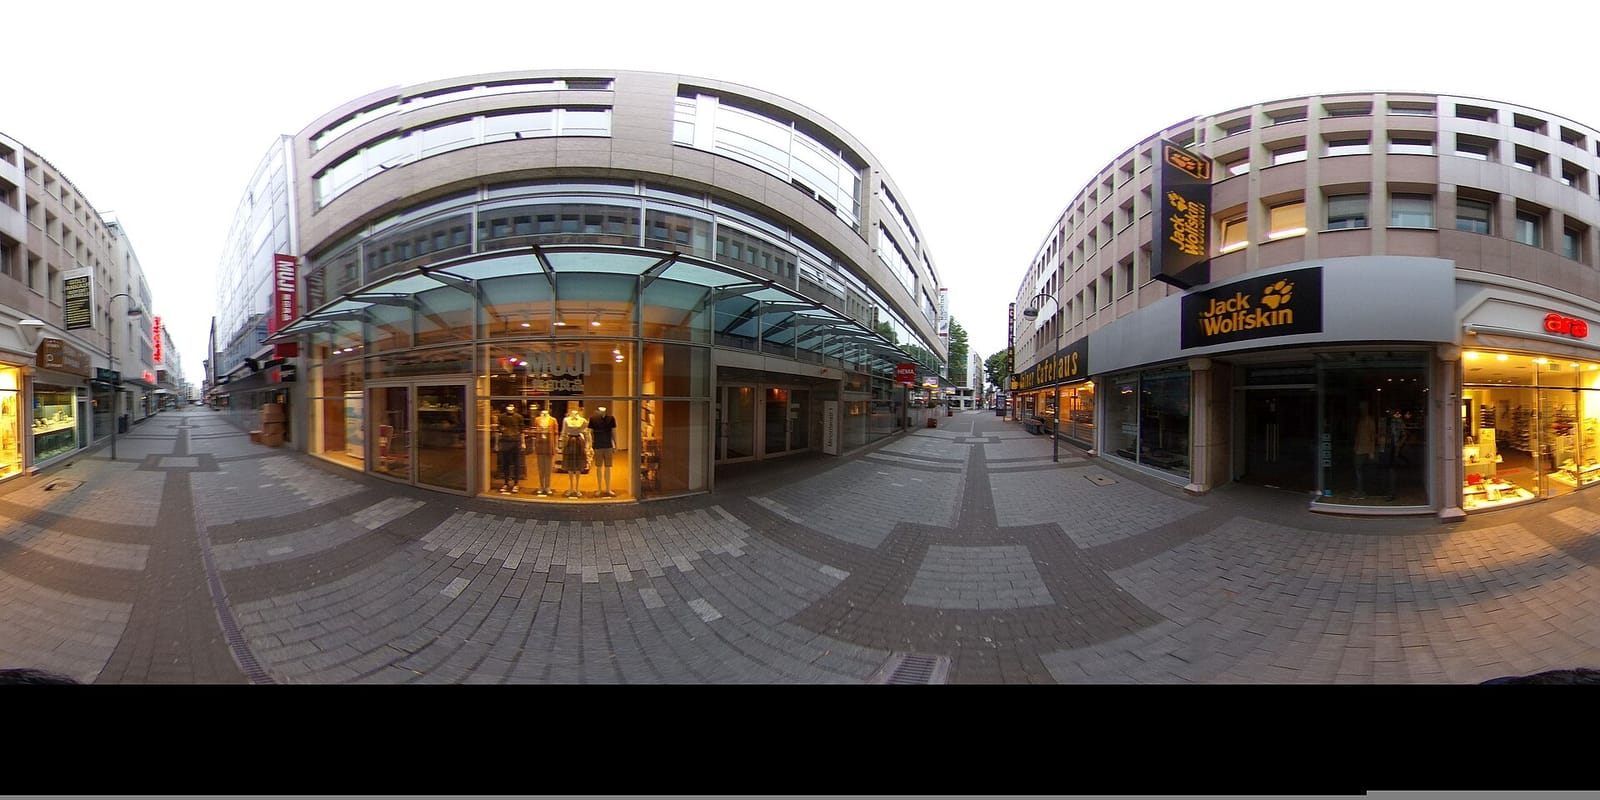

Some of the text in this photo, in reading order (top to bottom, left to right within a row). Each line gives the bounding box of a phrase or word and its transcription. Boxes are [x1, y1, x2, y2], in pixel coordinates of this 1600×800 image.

[1169, 214, 1184, 250] Jack
[1184, 201, 1205, 255] Wolfskin
[276, 260, 295, 292] MUJI
[1204, 292, 1251, 317] Jack
[1203, 308, 1294, 336] Wolfskin
[1544, 313, 1588, 339] ara
[527, 350, 591, 376] MUJI
[897, 368, 915, 376] HEMA
